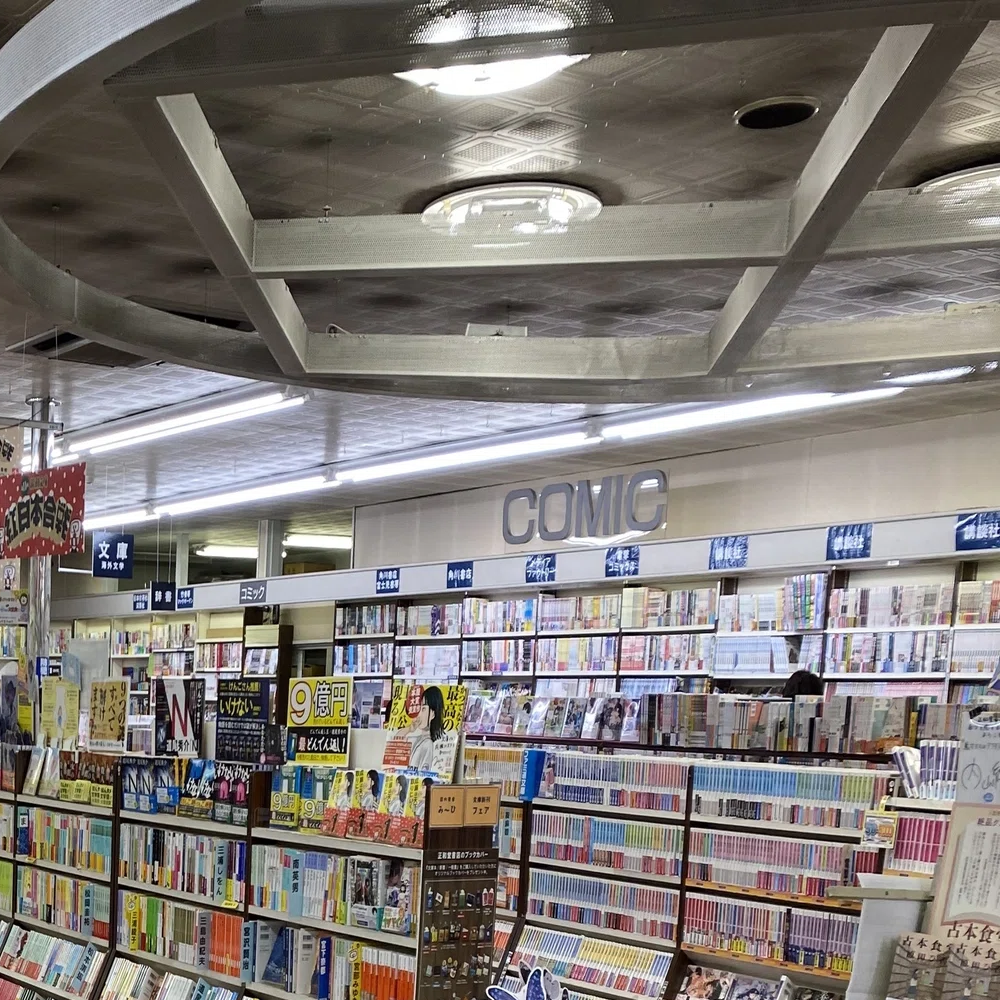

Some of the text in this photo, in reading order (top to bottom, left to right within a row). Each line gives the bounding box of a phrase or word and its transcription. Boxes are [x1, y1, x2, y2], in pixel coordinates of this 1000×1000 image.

[502, 468, 667, 545] COMIC
[99, 541, 128, 560] 文庫
[101, 560, 125, 571] 海外文学
[241, 585, 265, 600] コミック
[171, 694, 188, 739] N
[290, 681, 348, 725] 9億円
[216, 845, 224, 895] 三浦しをん
[948, 921, 1000, 944] 古本食
